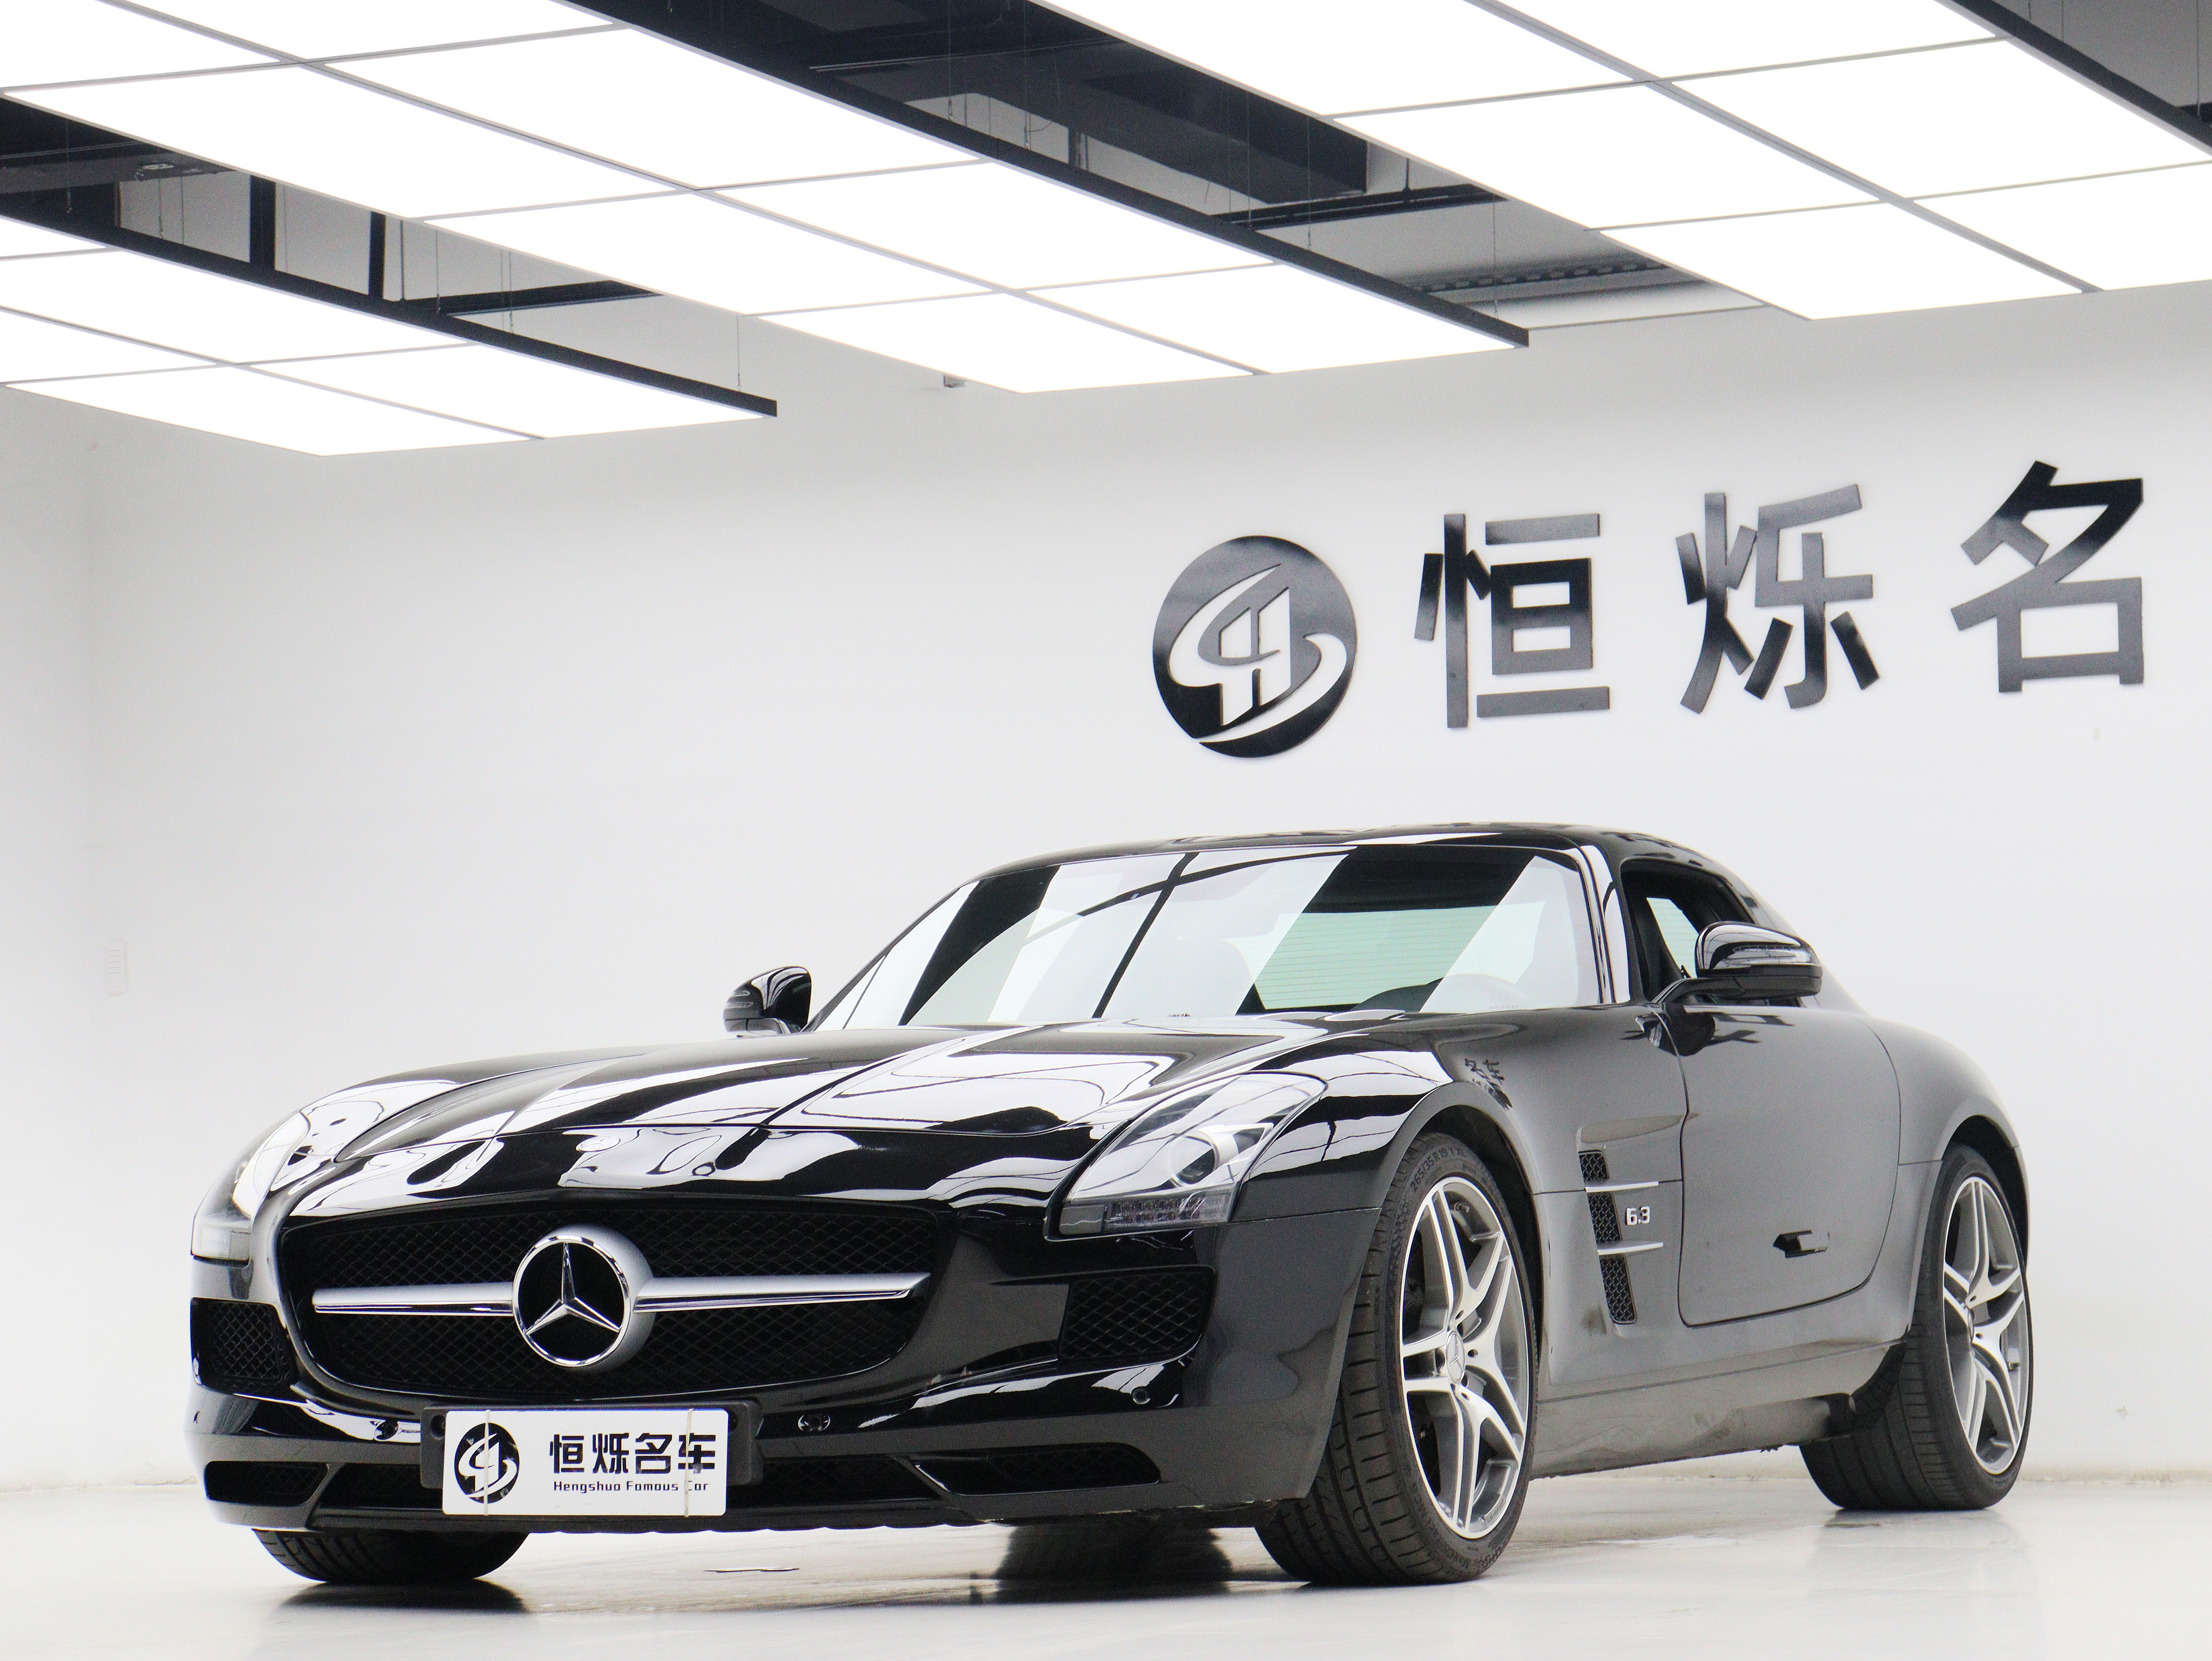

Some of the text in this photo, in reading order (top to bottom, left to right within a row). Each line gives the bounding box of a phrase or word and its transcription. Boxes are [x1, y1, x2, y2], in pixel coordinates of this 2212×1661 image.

[1415, 461, 2143, 728] 恒烁名
[1410, 1156, 1434, 1193] 265/35
[1625, 1205, 1651, 1225] 6.3
[549, 1433, 716, 1474] 恒烁名车
[554, 1481, 621, 1494] Hengshuo
[626, 1480, 679, 1491] Famous
